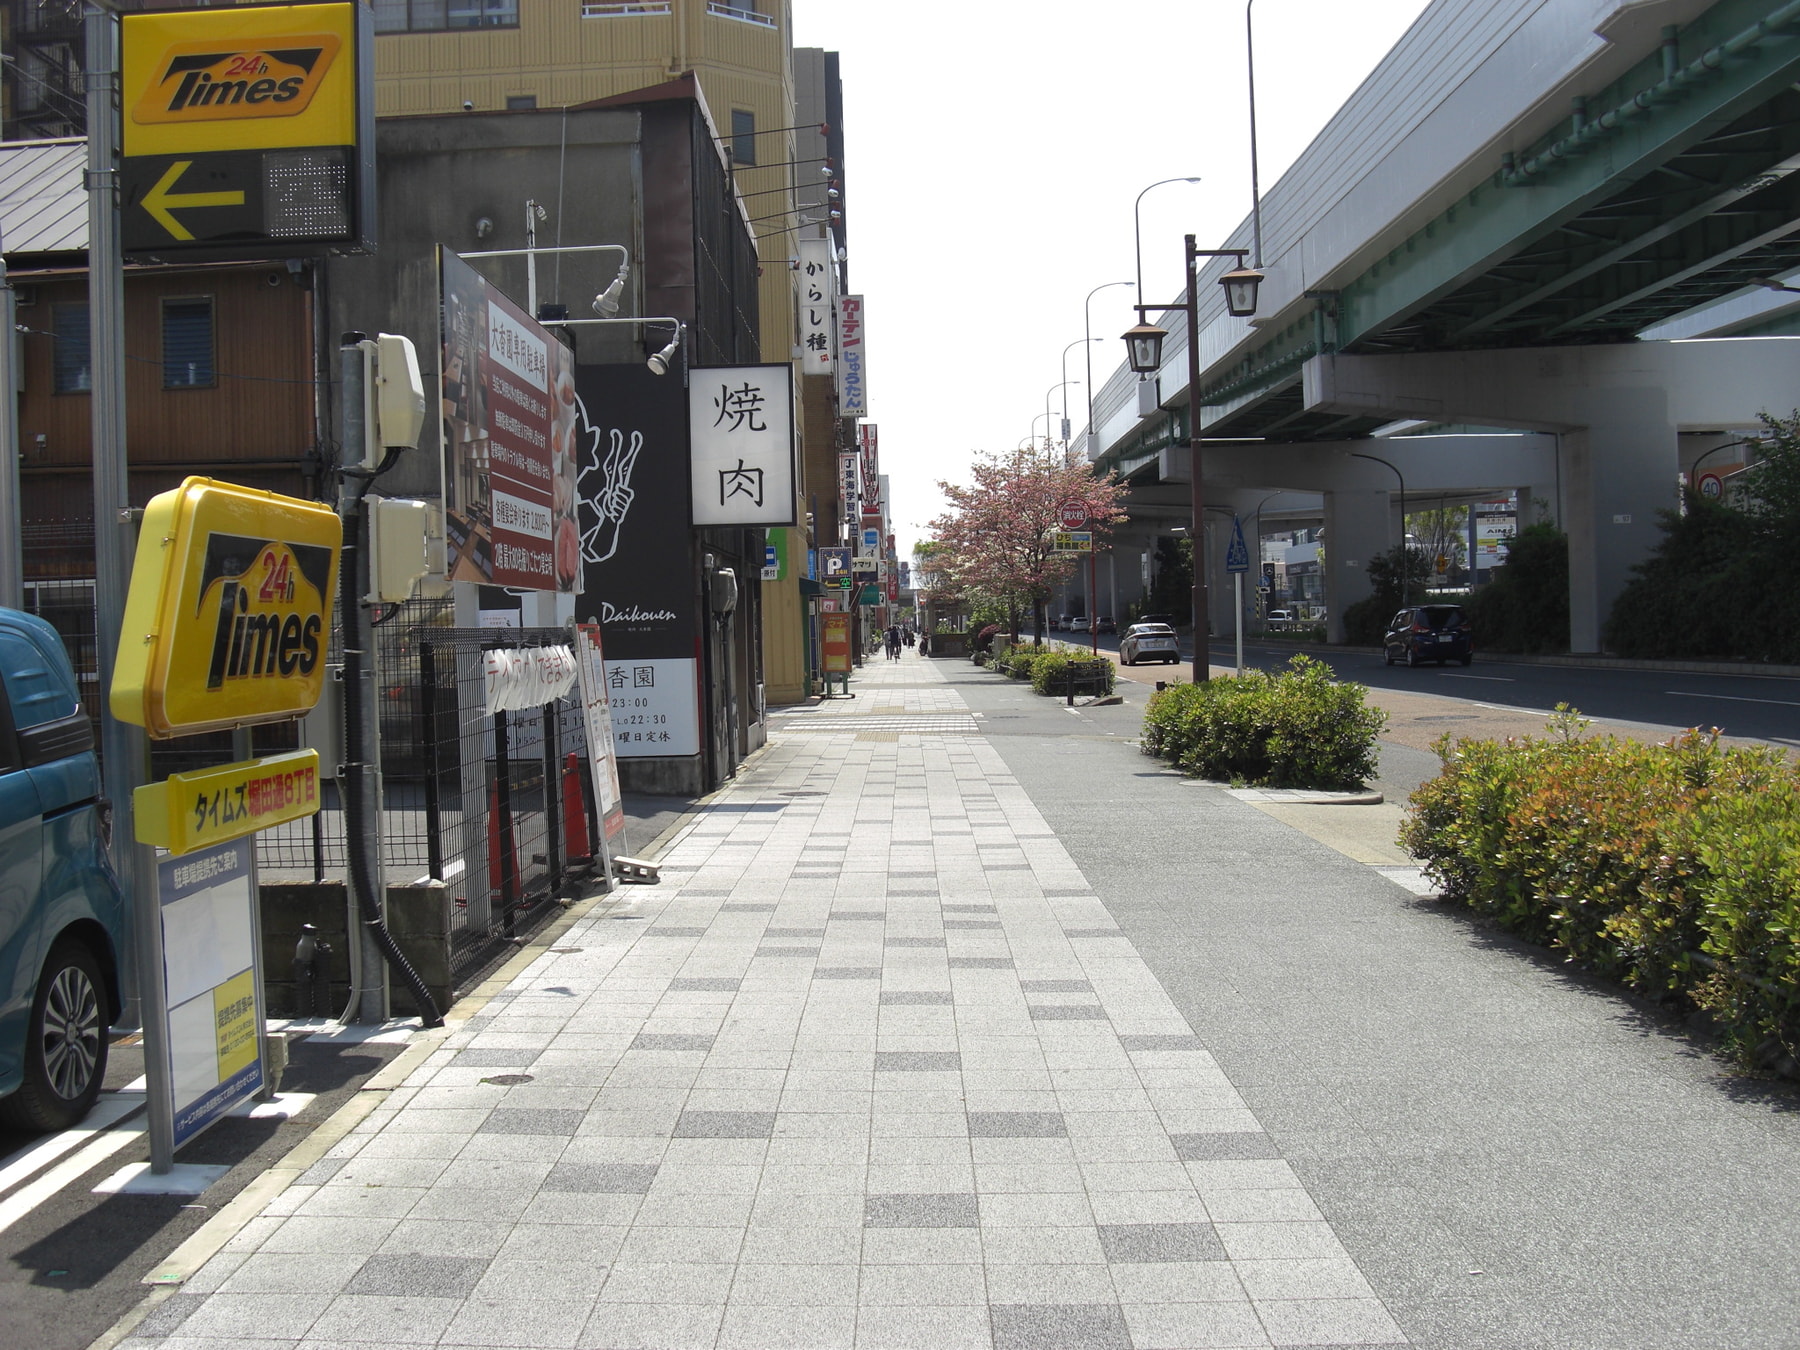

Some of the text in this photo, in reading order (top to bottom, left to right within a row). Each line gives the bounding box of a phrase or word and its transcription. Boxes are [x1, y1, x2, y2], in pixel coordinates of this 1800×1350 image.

[225, 55, 268, 76] 24h
[167, 71, 304, 111] Times
[805, 260, 828, 352] からし種
[842, 298, 860, 348] カーテン
[843, 350, 861, 409] じゅうたん
[713, 381, 768, 508] 焼肉
[1703, 482, 1718, 496] 40
[1063, 510, 1084, 520] 消火栓
[259, 550, 295, 604] 24h
[601, 601, 677, 624] Daikouen
[206, 579, 322, 692] Times
[611, 731, 671, 743] 曜日定休
